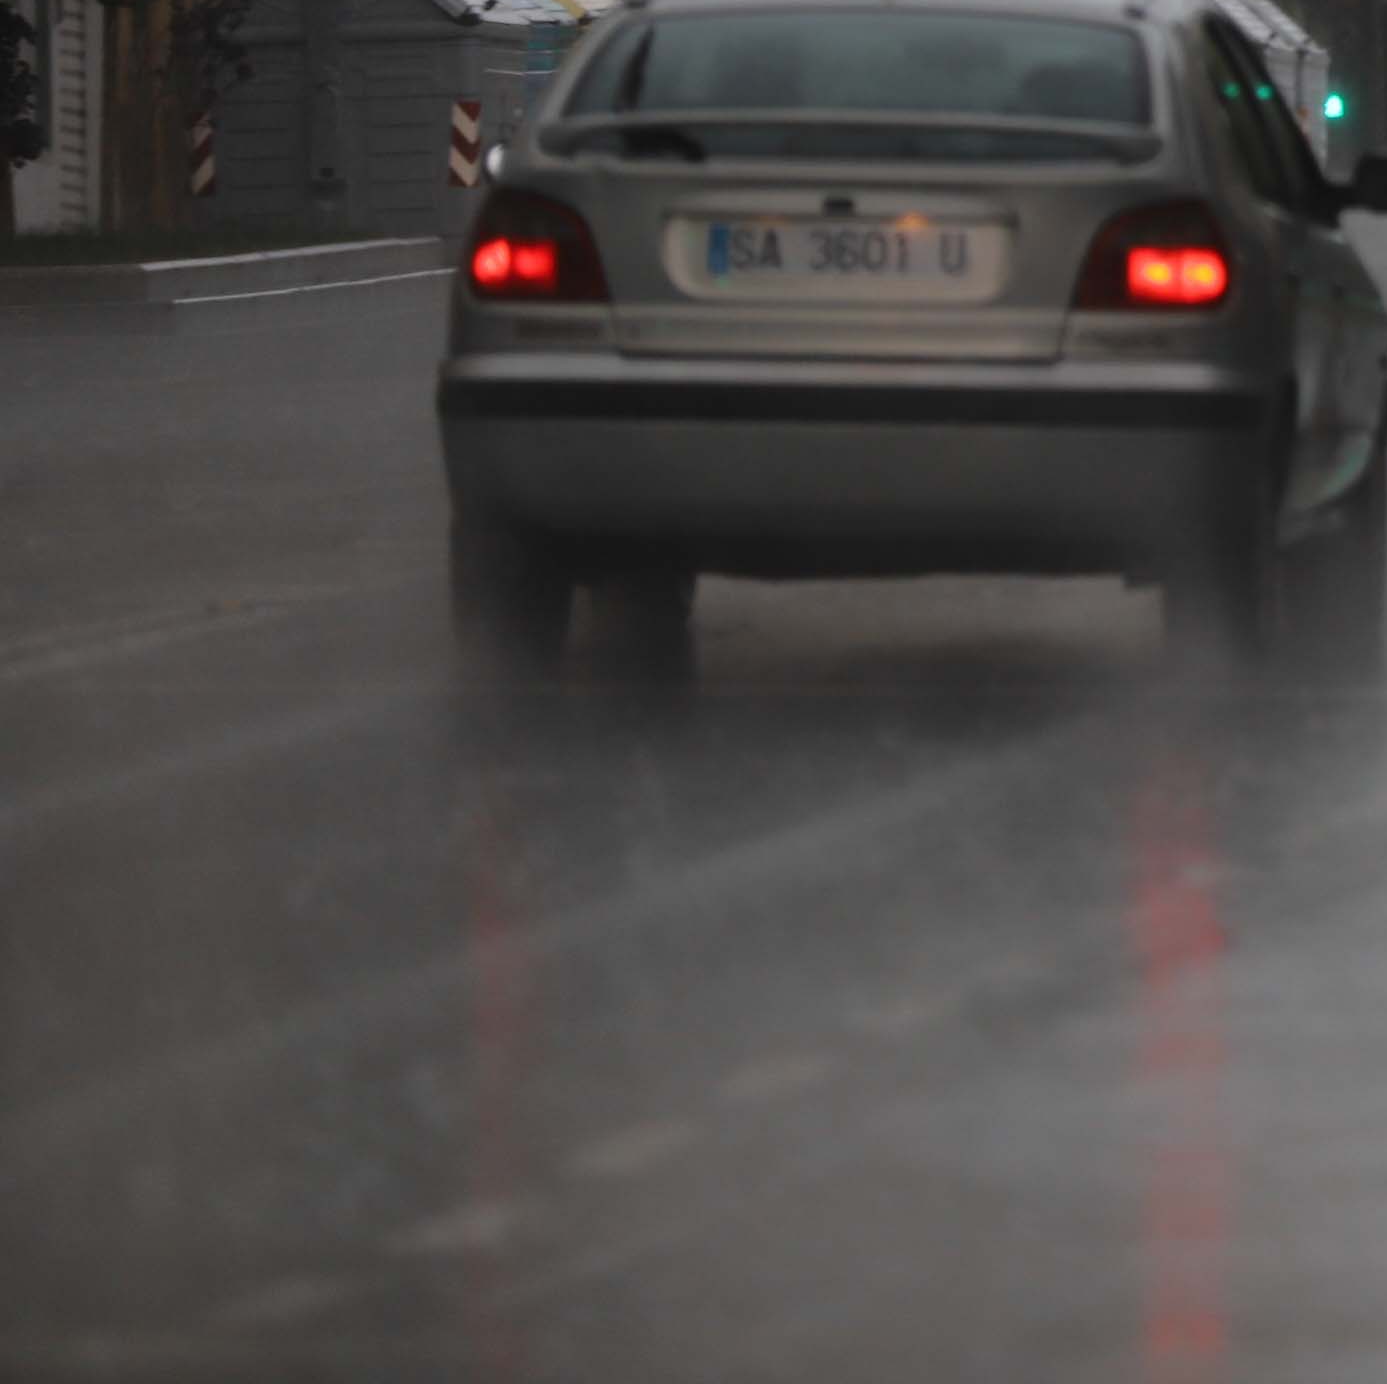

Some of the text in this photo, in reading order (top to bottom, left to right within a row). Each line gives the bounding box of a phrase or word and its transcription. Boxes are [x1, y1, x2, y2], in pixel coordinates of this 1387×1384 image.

[731, 228, 968, 275] SA 3601 U
